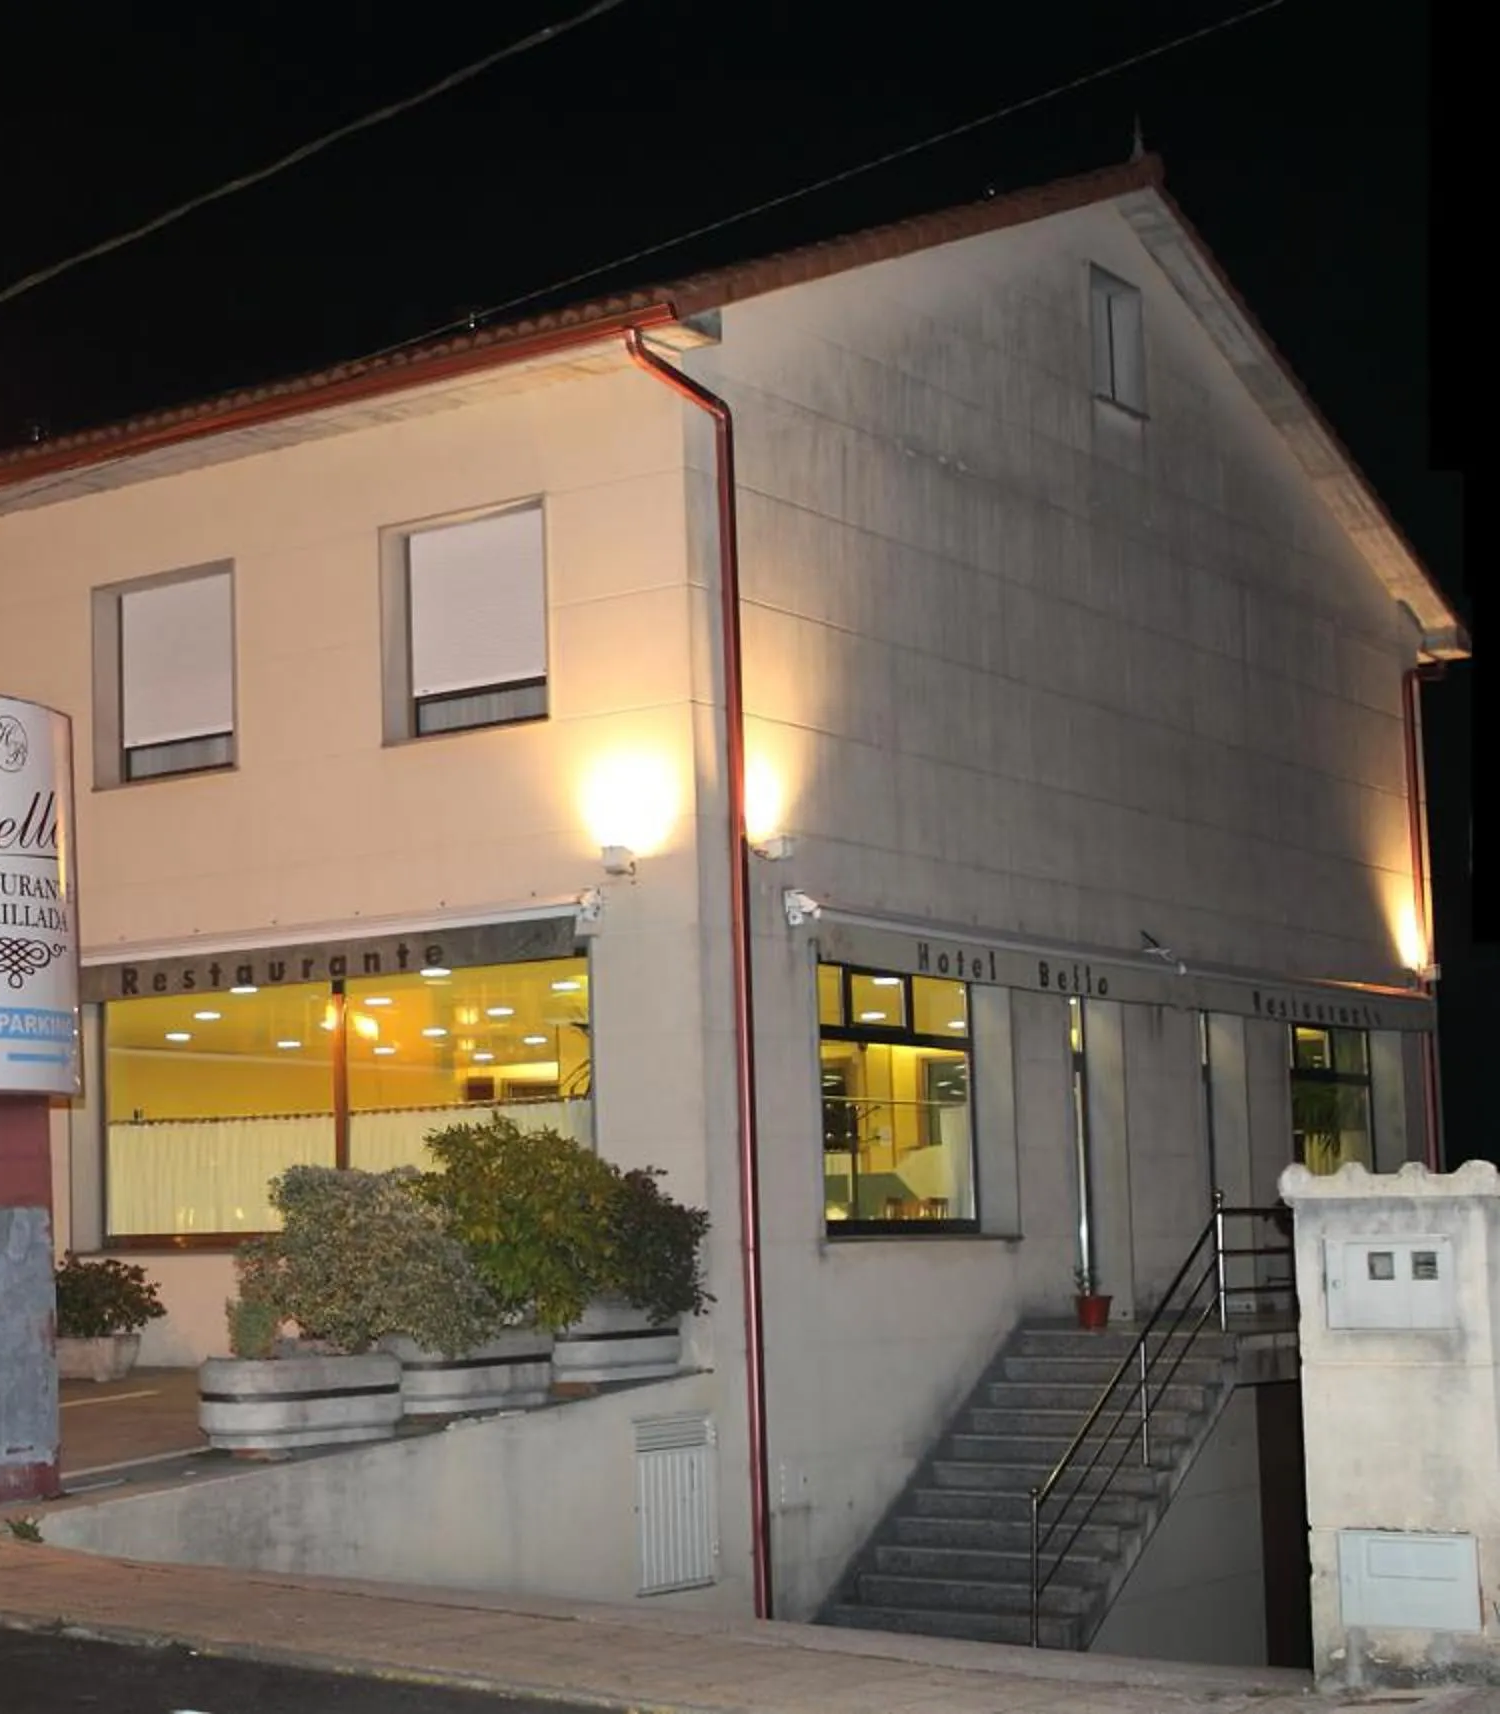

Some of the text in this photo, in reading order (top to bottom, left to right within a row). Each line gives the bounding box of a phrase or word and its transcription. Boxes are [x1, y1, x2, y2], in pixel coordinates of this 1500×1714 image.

[121, 942, 445, 996] Restaurante
[917, 942, 996, 980] Hotel
[1038, 960, 1109, 995] Bello
